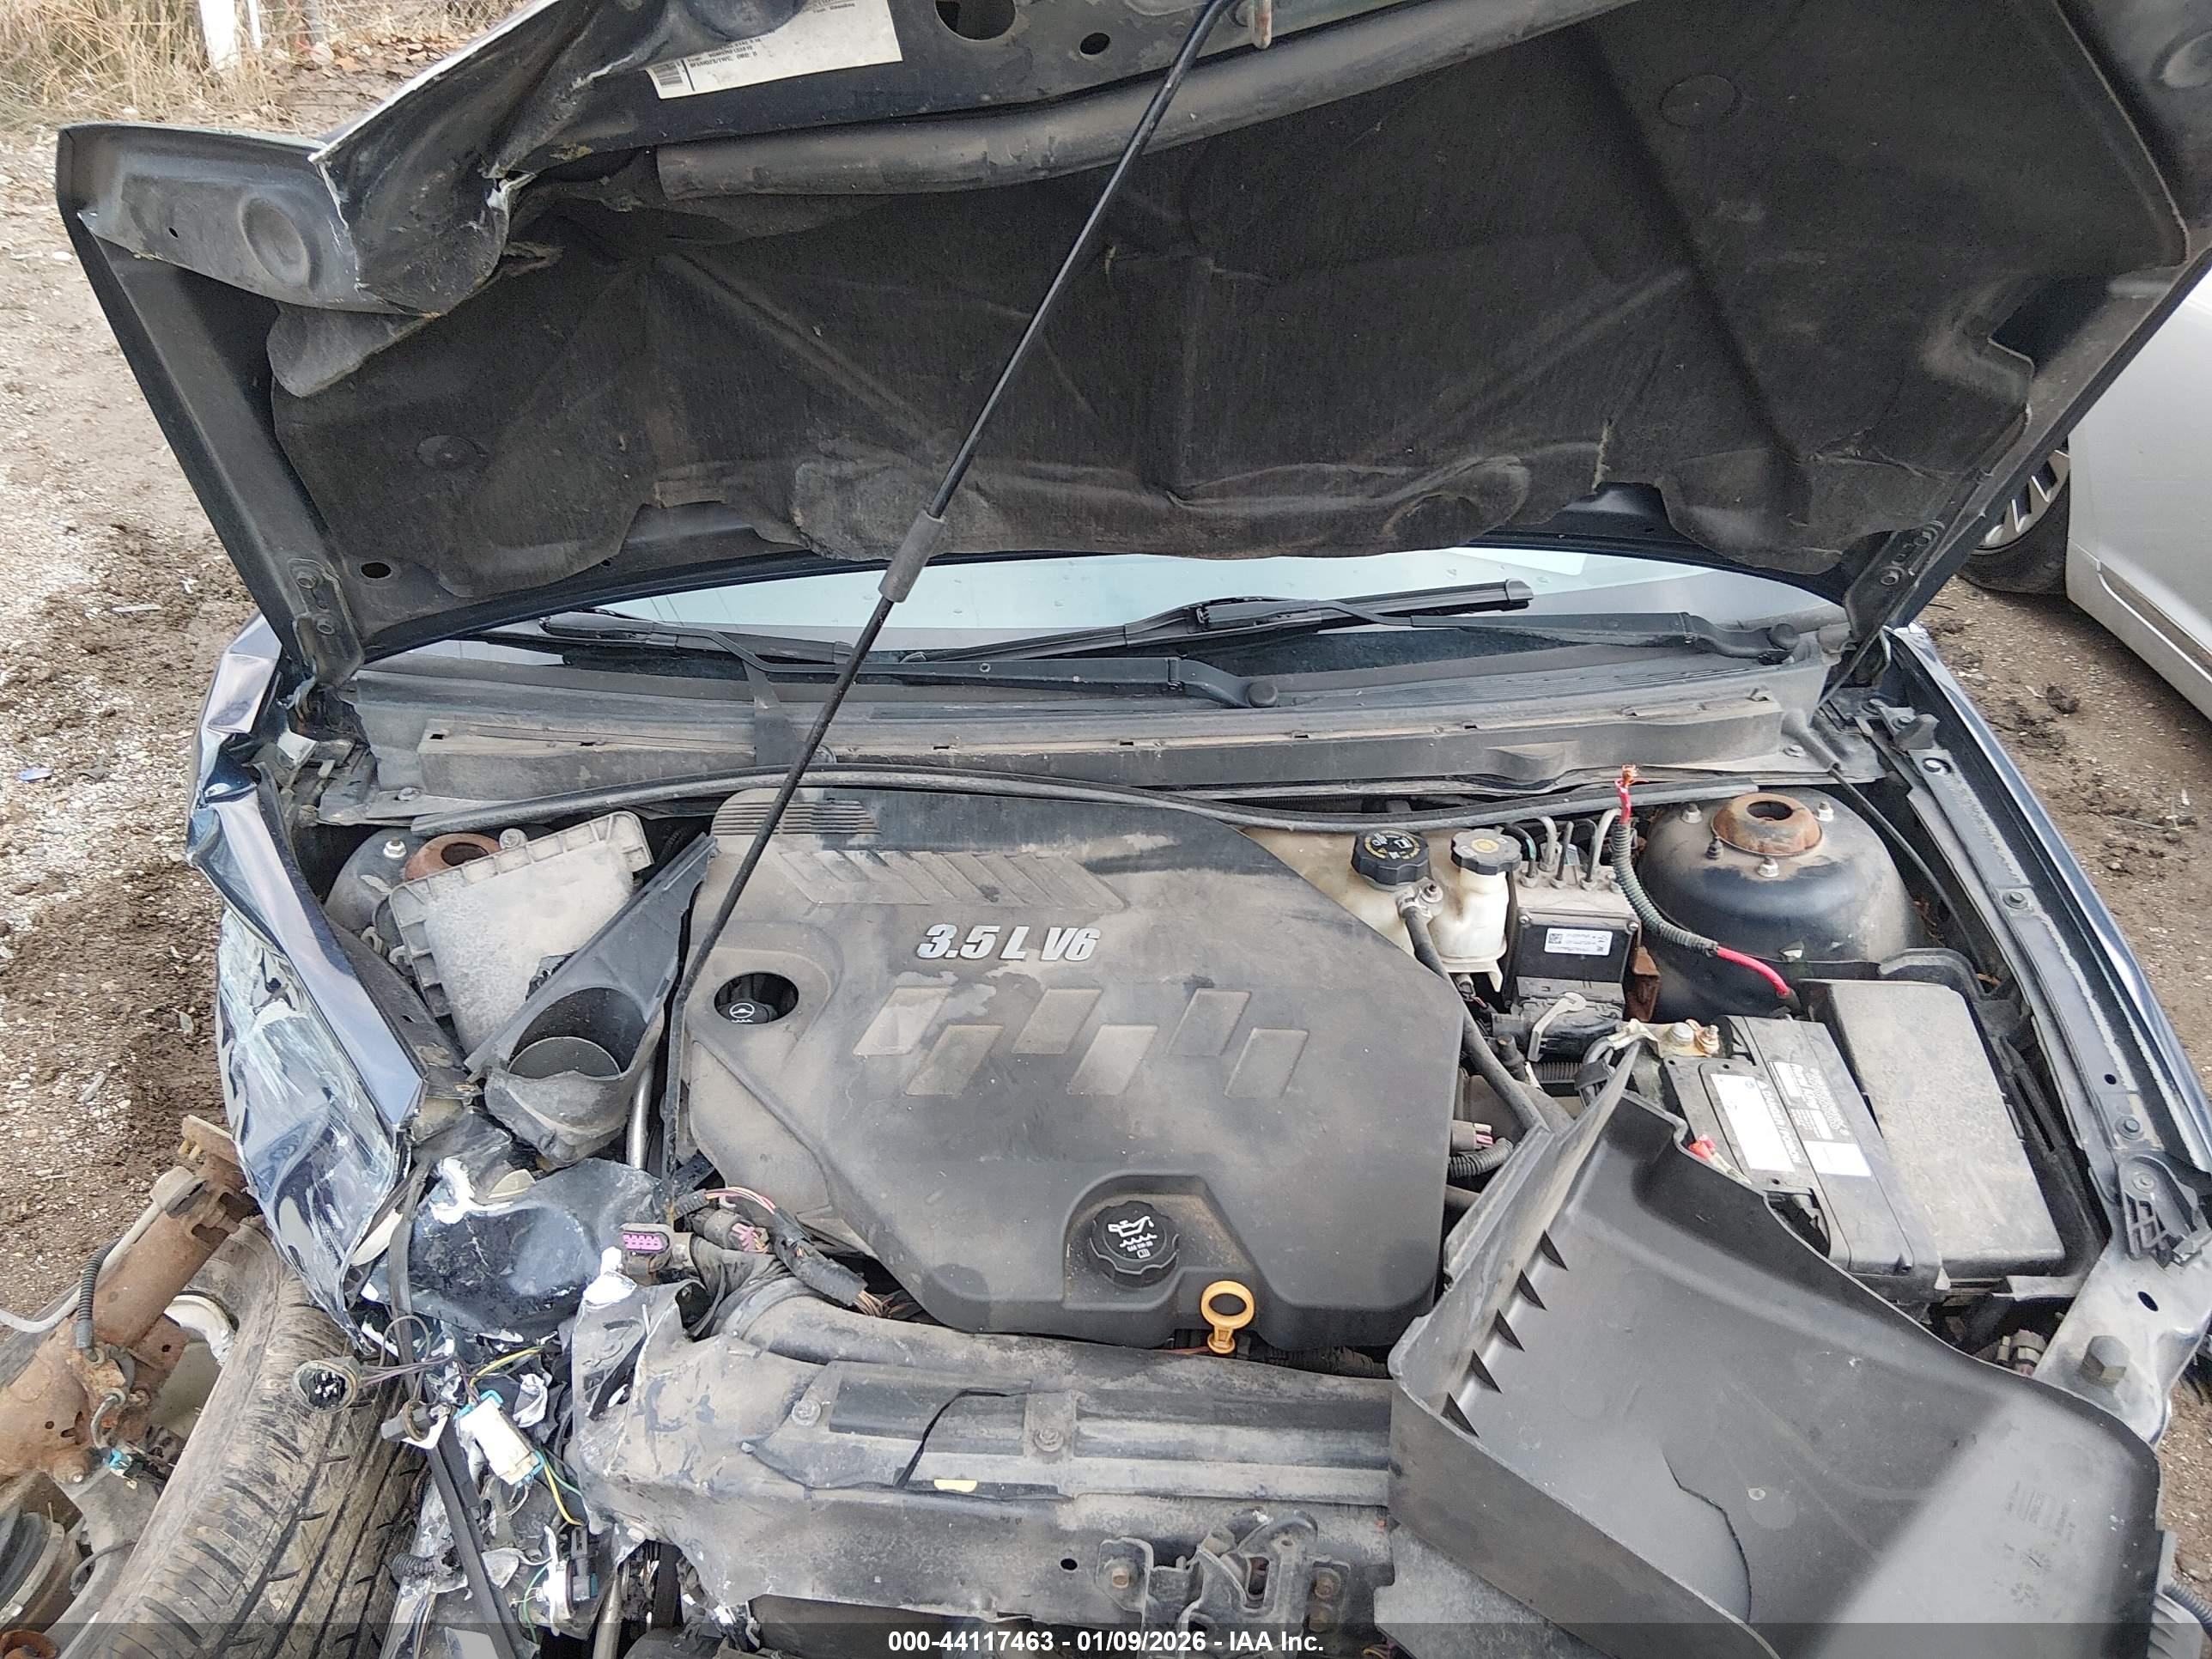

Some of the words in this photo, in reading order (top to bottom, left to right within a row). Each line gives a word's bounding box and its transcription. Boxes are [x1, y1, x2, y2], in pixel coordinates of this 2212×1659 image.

[916, 923, 1001, 960] 3.5
[999, 926, 1030, 960] L
[1040, 927, 1102, 962] V6
